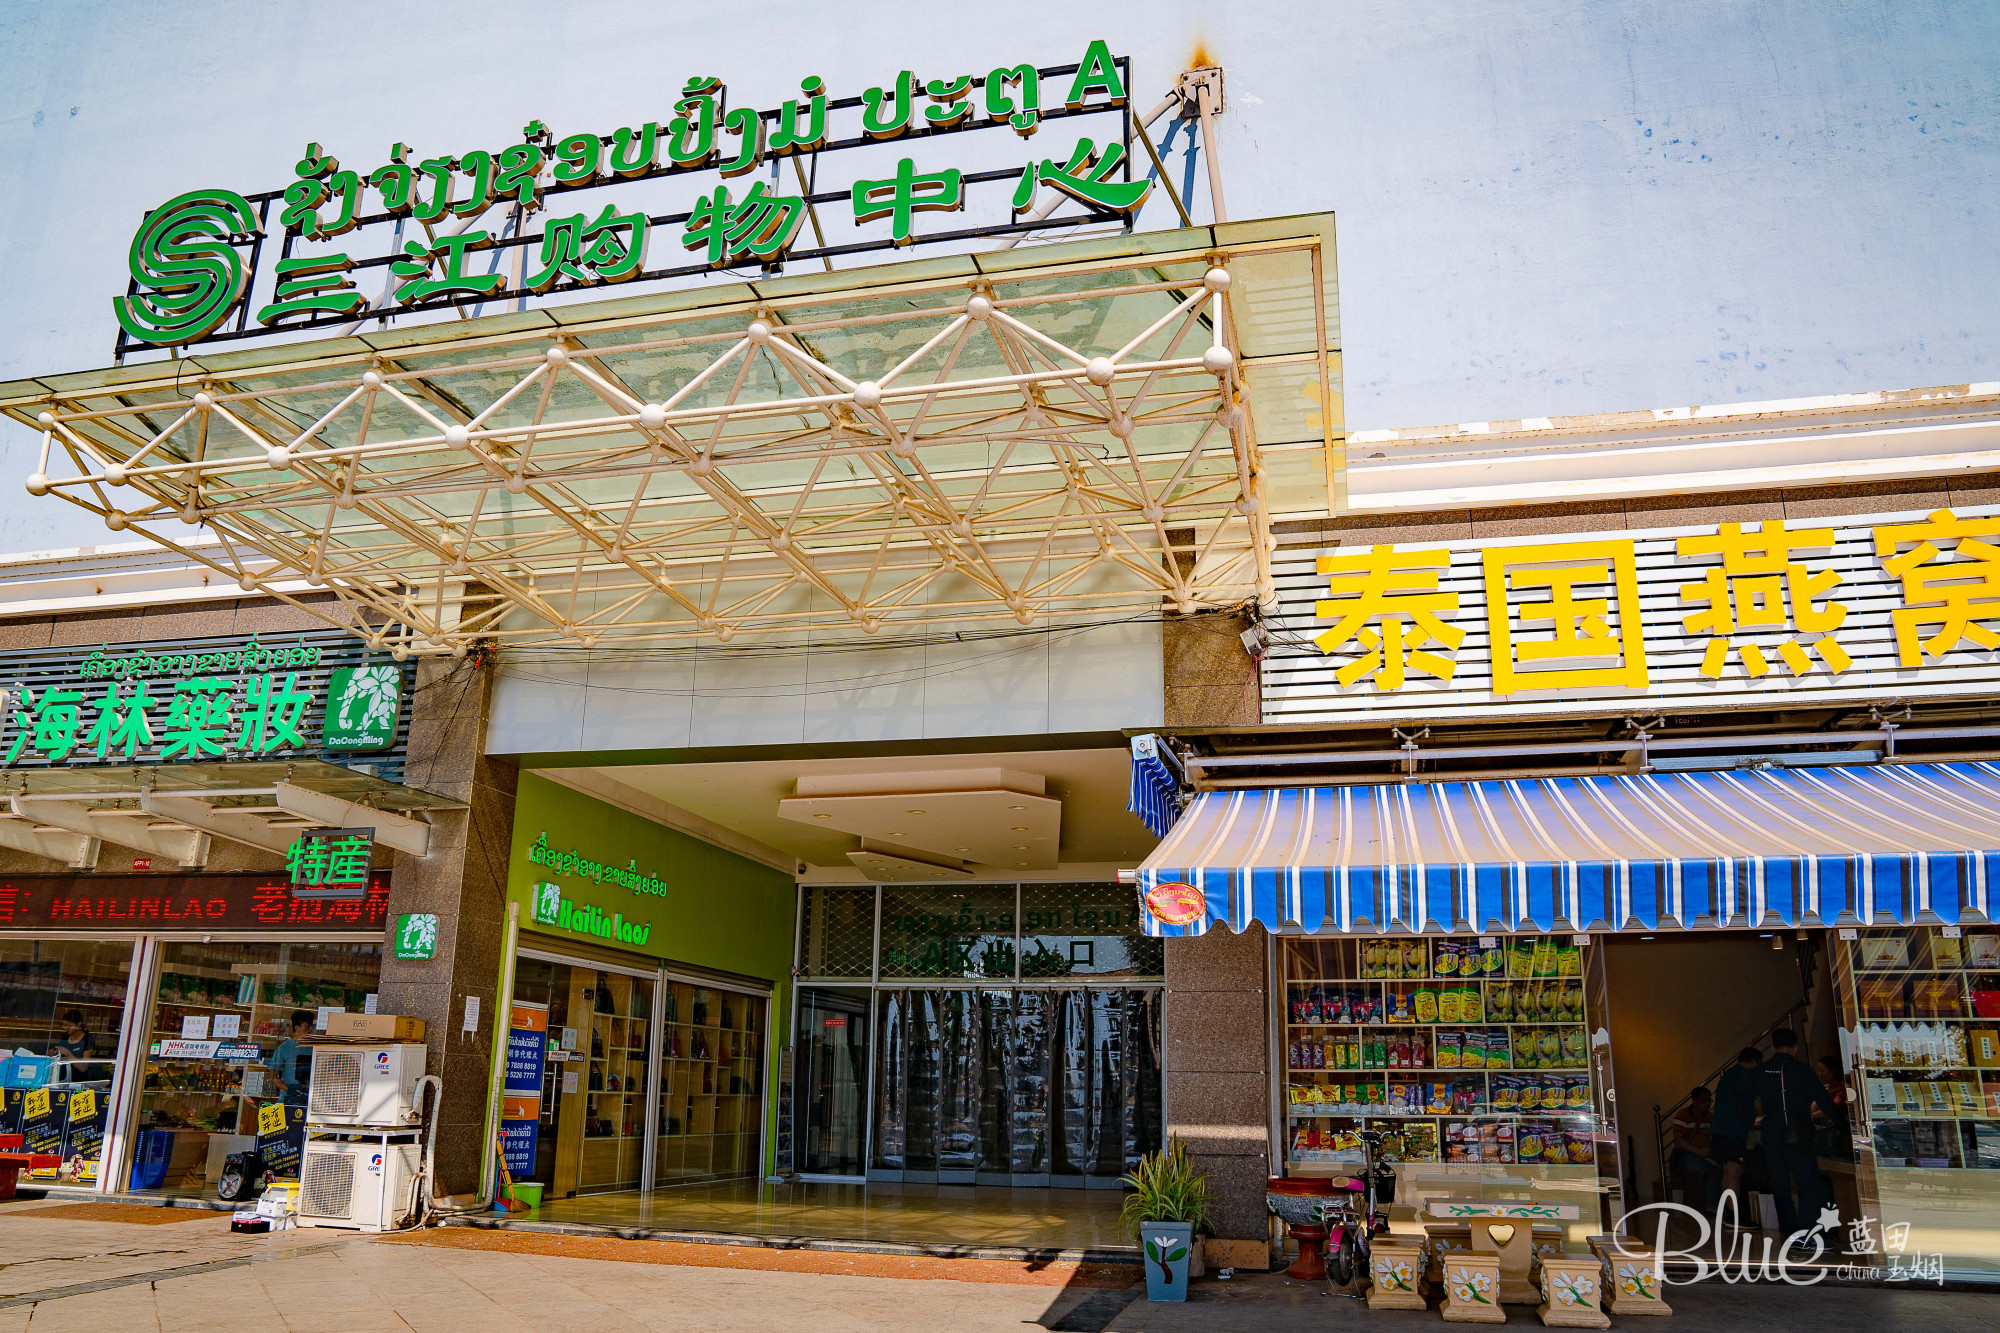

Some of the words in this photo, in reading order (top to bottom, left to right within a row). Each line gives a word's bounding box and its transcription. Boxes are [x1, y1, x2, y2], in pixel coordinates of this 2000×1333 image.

[1066, 39, 1126, 110] A
[256, 138, 1153, 326] 三江购物中心
[1313, 506, 2000, 695] 泰国燕窝
[51, 898, 227, 919] HAILINLAO
[515, 1162, 528, 1170] 7777
